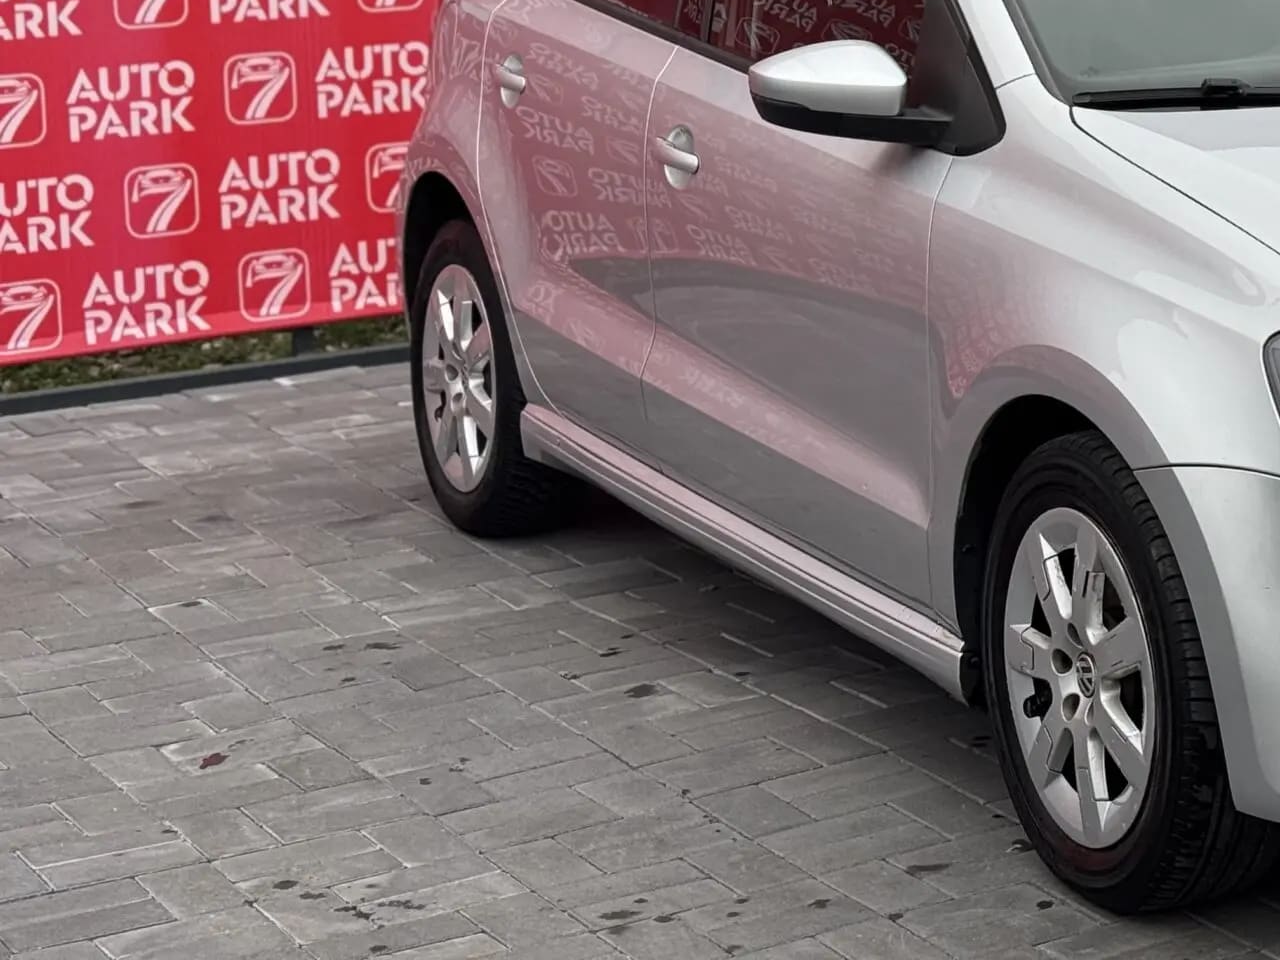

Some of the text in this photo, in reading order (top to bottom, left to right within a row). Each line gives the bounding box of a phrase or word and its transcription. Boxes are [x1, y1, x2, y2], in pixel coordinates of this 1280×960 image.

[66, 60, 195, 104] AUTO
[315, 42, 428, 82] AUTO
[69, 96, 195, 142] PARK
[219, 148, 340, 193] AUTO
[220, 183, 341, 230] PARK
[83, 260, 210, 308] AUTO
[85, 296, 211, 345] PARK
